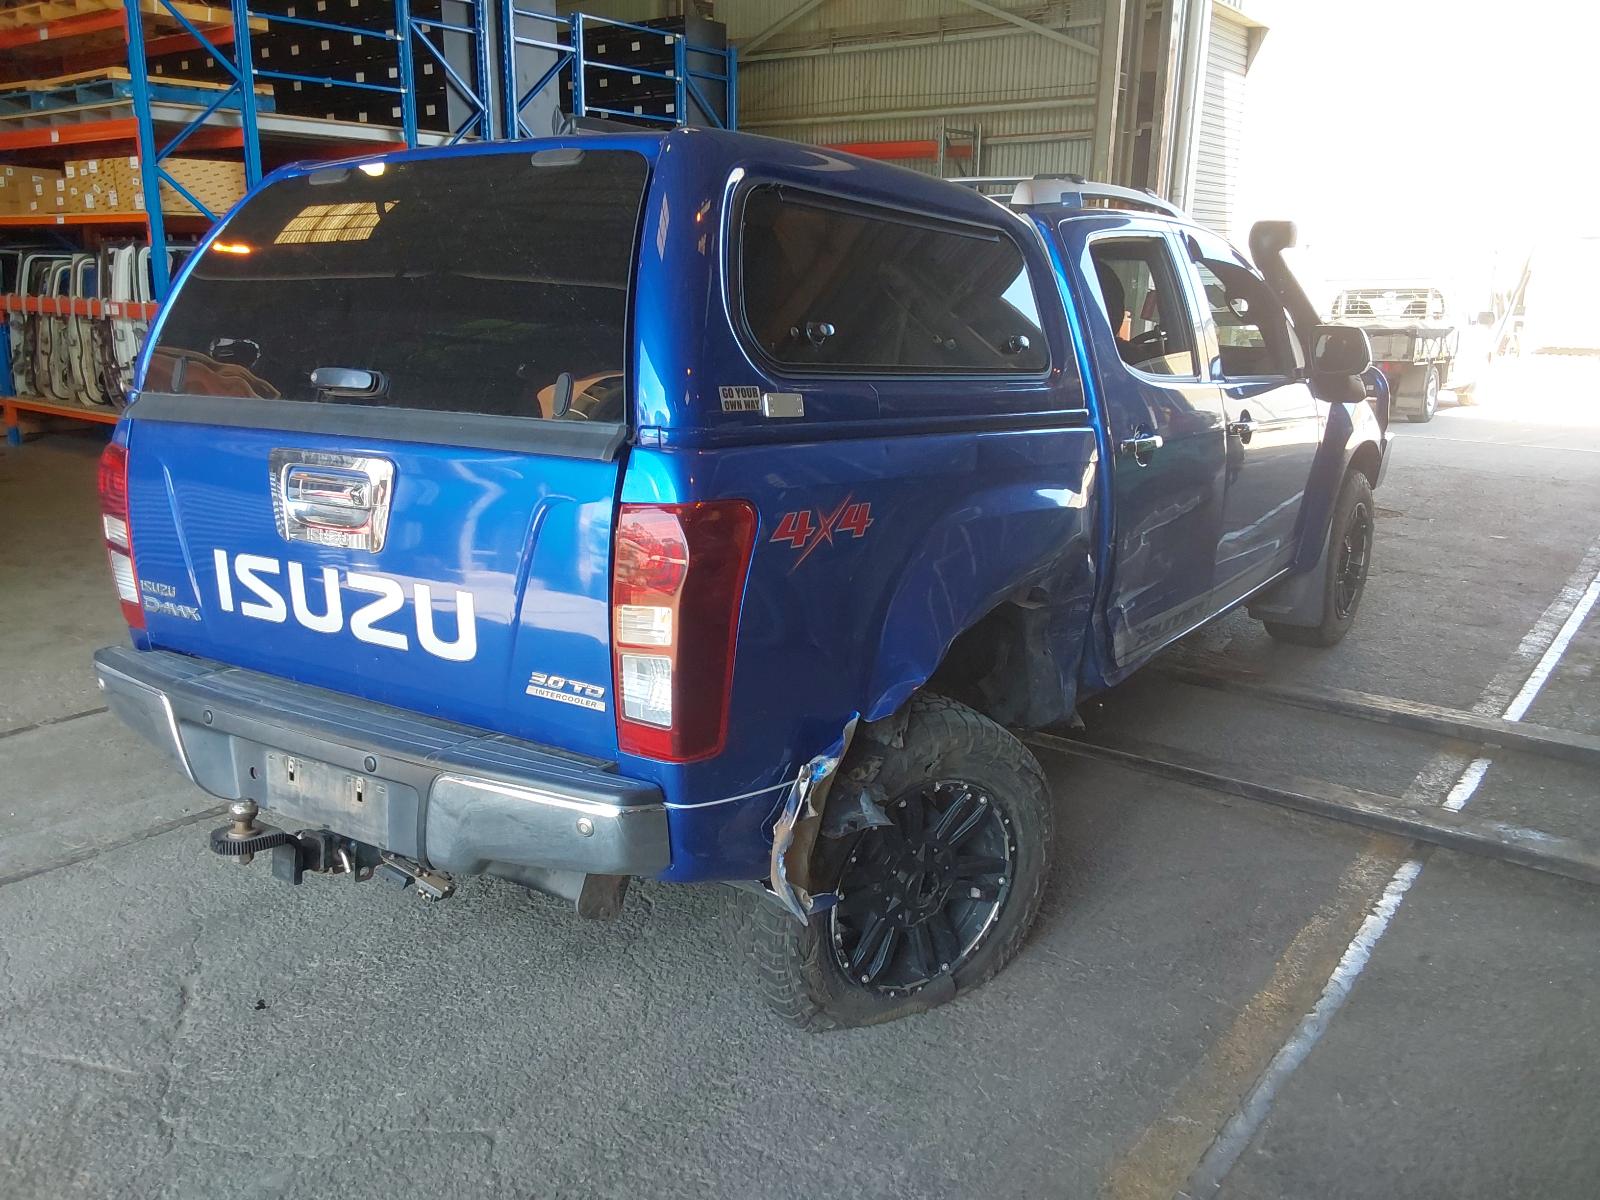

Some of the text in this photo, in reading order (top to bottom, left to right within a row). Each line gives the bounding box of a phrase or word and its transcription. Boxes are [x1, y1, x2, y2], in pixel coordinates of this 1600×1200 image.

[722, 387, 759, 399] GO YOUR
[724, 400, 760, 410] OWN WAY
[140, 580, 176, 597] ISUZU
[213, 549, 478, 662] ISUZU
[534, 688, 598, 708] INTERCOOLER
